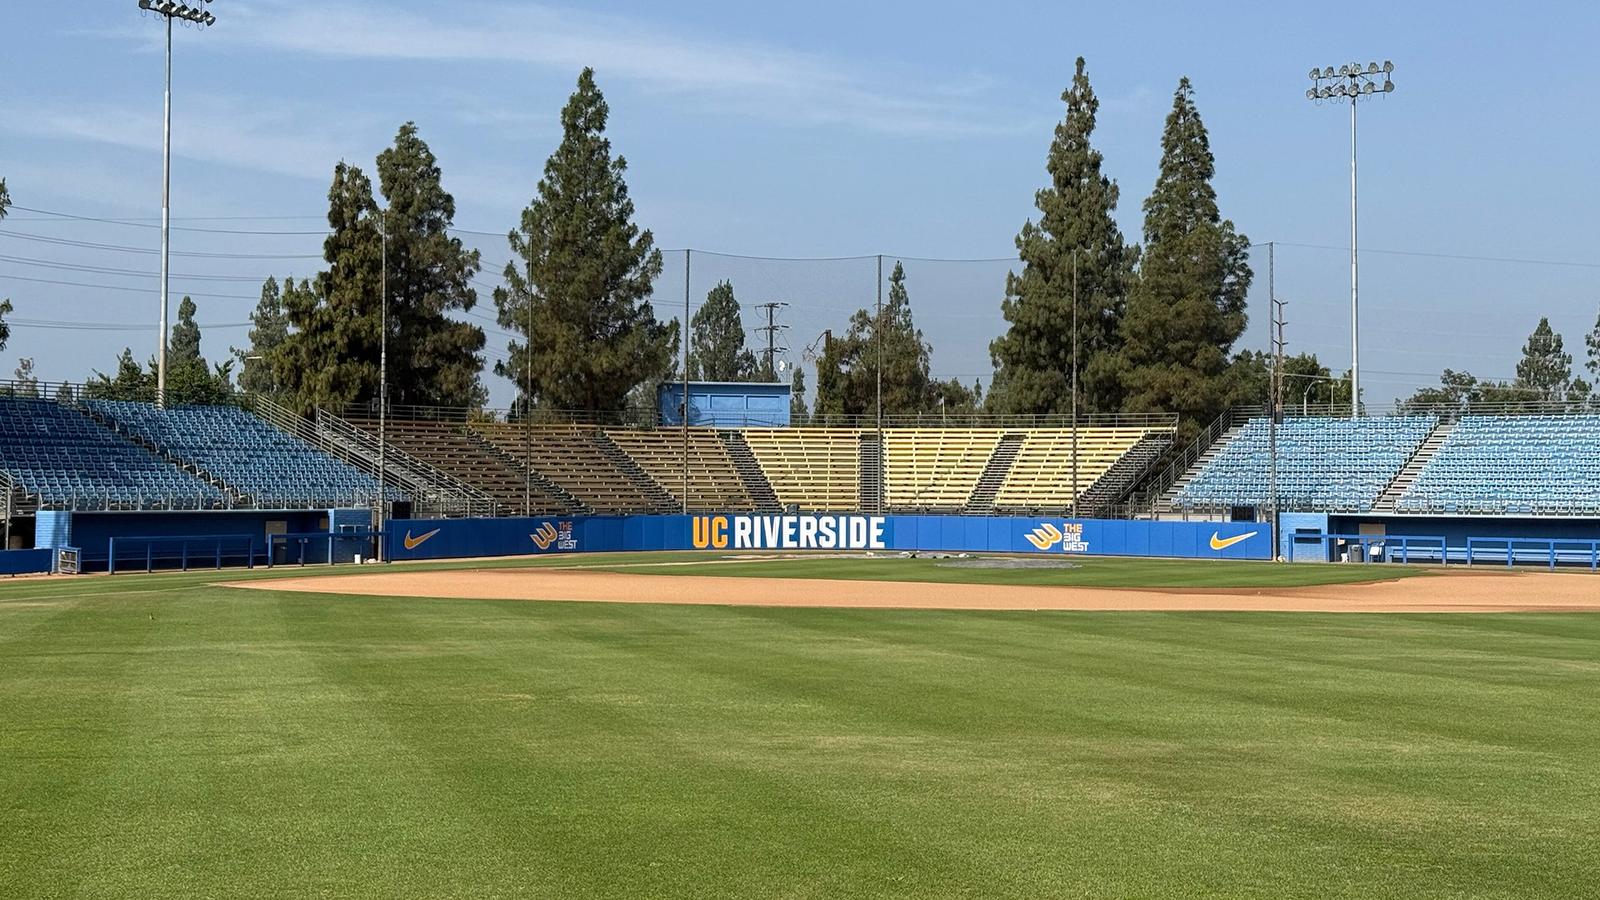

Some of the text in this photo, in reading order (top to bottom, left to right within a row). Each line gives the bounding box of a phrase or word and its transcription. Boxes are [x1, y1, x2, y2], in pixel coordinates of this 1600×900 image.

[558, 521, 573, 530] THE
[1063, 523, 1082, 533] THE
[693, 516, 885, 548] UC RIVERSIDE
[1063, 533, 1081, 542] BIG
[558, 540, 577, 549] WEST
[1063, 541, 1089, 551] WEST
